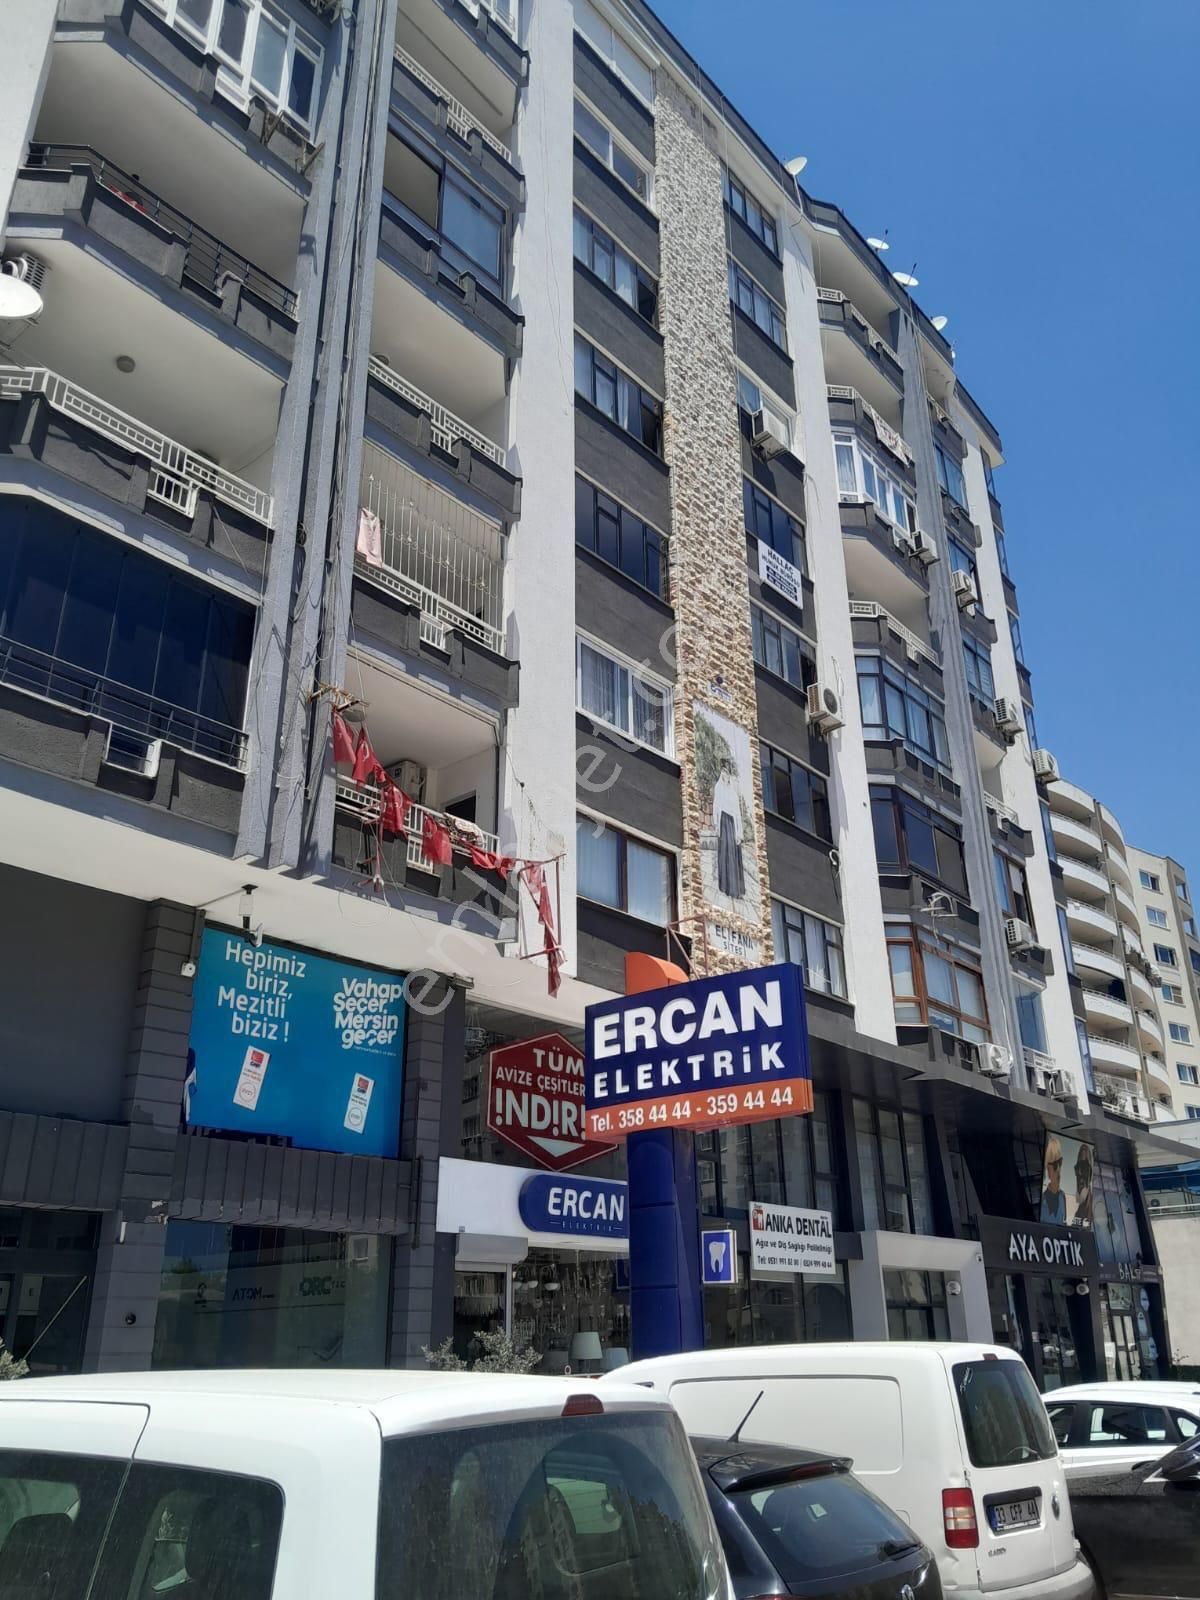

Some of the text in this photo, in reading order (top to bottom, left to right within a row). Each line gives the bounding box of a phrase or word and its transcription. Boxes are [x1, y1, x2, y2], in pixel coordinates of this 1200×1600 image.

[225, 940, 306, 978] Hepimiz
[246, 968, 293, 999] biriz,
[342, 978, 402, 1002] Vahap
[217, 985, 286, 1019] Mezitli
[335, 1010, 399, 1030] Mersin
[593, 980, 783, 1060] ERCAN
[341, 1029, 397, 1050] geçer
[495, 1065, 533, 1087] AVİZE
[532, 1046, 585, 1077] TÜM
[591, 1113, 614, 1133] Tel.
[618, 1107, 645, 1130] 358
[648, 1104, 667, 1123] 44
[672, 1100, 692, 1120] 44
[706, 1093, 738, 1116] 359
[743, 1090, 765, 1110] 44
[770, 1086, 793, 1106] 44
[547, 1187, 625, 1222] ERCAN
[765, 1213, 832, 1238] ANKA DENTAL
[1008, 1232, 1084, 1267] AYA OPTİK
